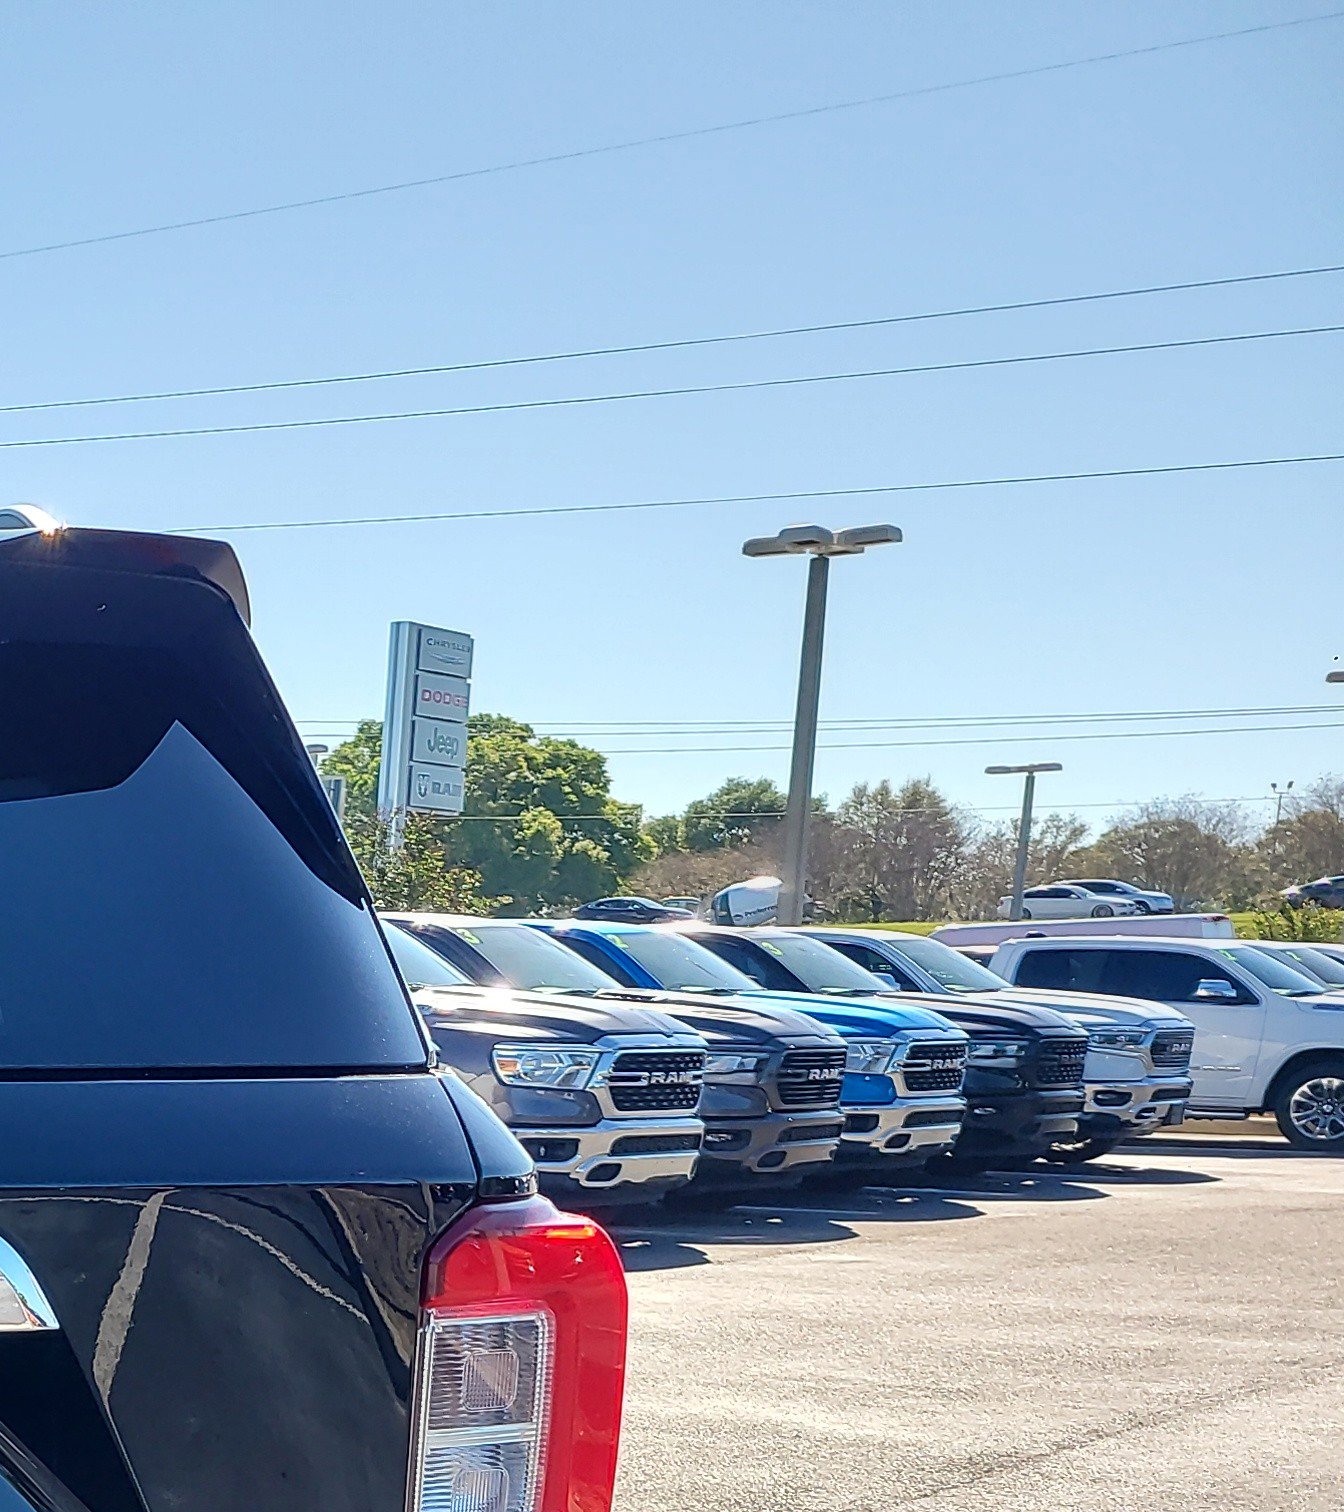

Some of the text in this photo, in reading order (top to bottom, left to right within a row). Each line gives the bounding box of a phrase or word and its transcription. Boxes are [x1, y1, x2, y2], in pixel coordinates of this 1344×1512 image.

[421, 688, 468, 708] DODGE
[427, 727, 459, 759] Jeep
[431, 781, 462, 797] RAM
[650, 1071, 694, 1084] RAM
[808, 1068, 841, 1081] RAM
